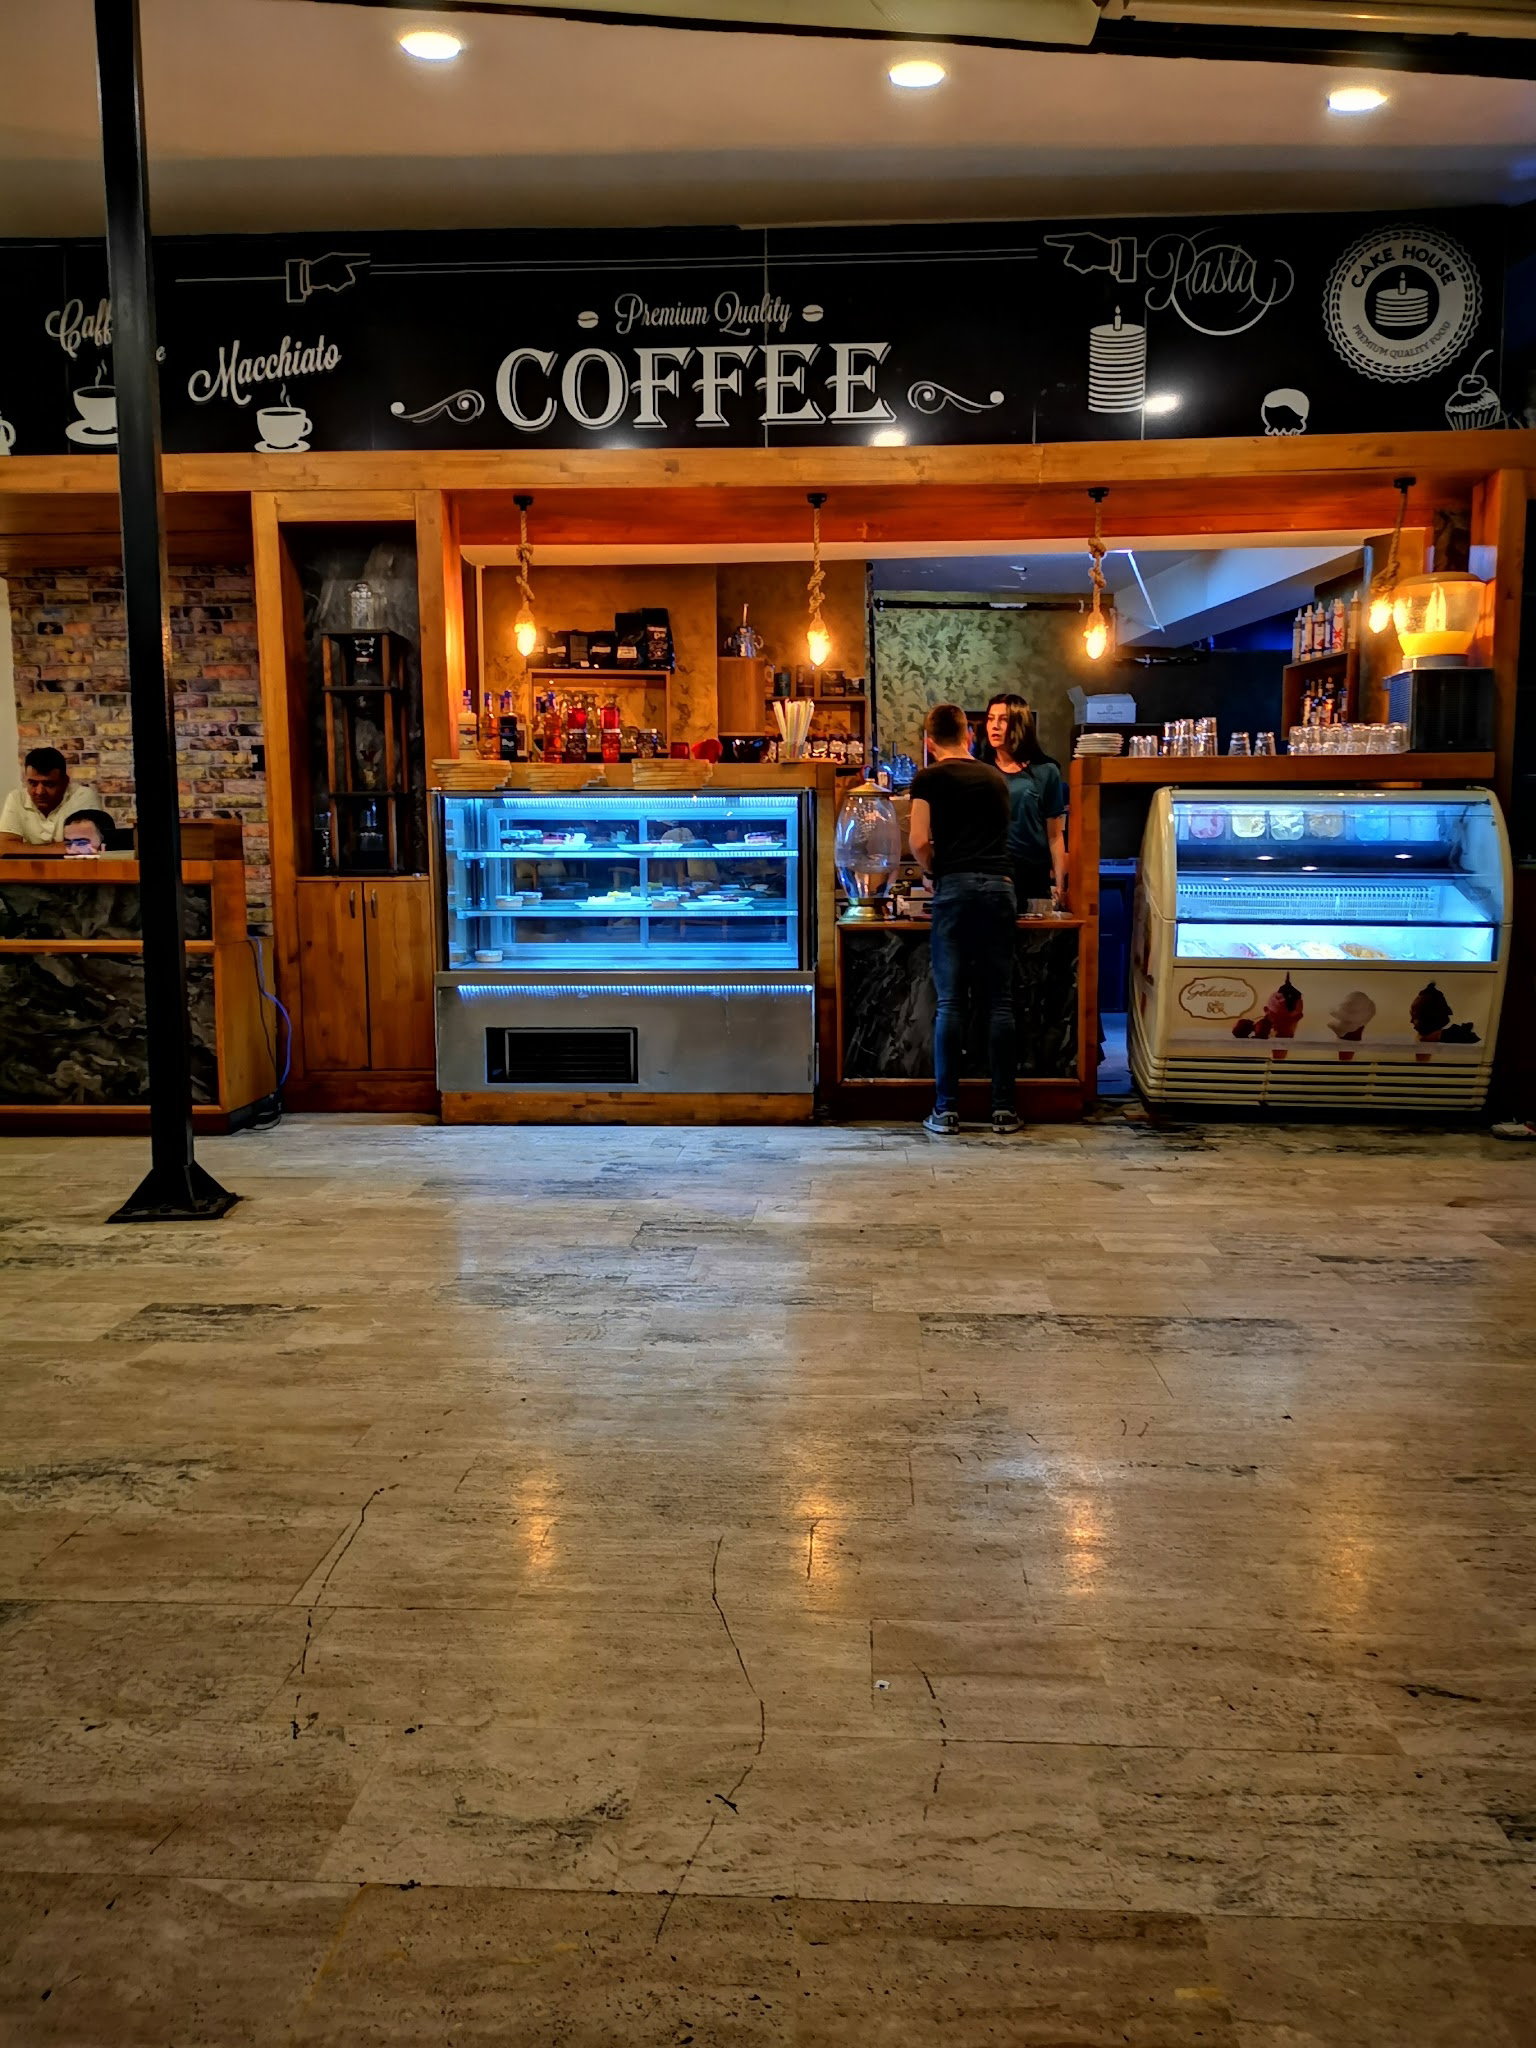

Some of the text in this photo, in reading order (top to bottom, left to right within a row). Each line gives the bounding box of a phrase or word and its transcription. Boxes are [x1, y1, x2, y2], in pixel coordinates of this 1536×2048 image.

[1145, 226, 1295, 336] Pasta
[1351, 244, 1457, 288] CAKE HOUSE
[44, 298, 113, 359] Caff
[614, 291, 792, 336] Premium Quality
[1352, 320, 1452, 360] PREMIUM QUALITY FOOD
[187, 334, 343, 406] Macchiato
[495, 342, 898, 432] COFFEE
